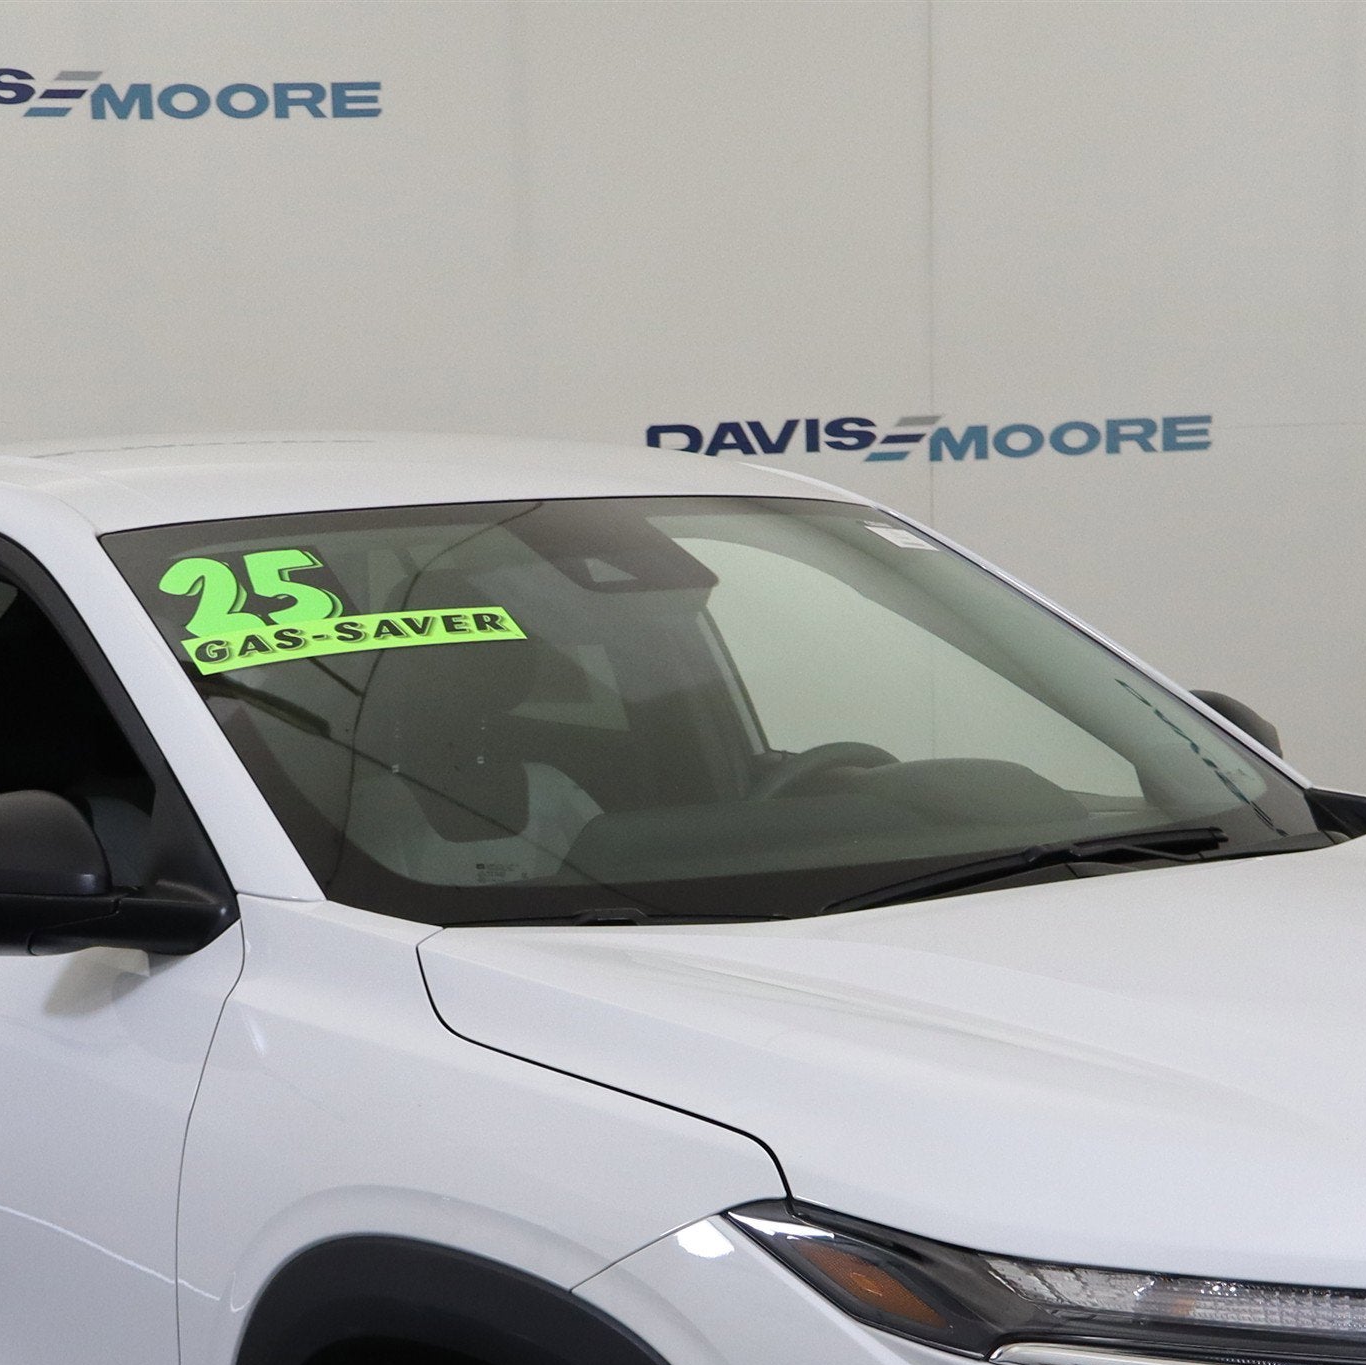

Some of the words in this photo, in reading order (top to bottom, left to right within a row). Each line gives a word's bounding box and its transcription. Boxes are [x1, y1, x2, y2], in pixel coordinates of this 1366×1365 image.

[90, 81, 383, 120] MOORE
[645, 416, 878, 457] DAVIS
[928, 414, 1212, 462] MOORE
[158, 549, 344, 637] 25
[194, 613, 508, 665] GAS-SAVER
